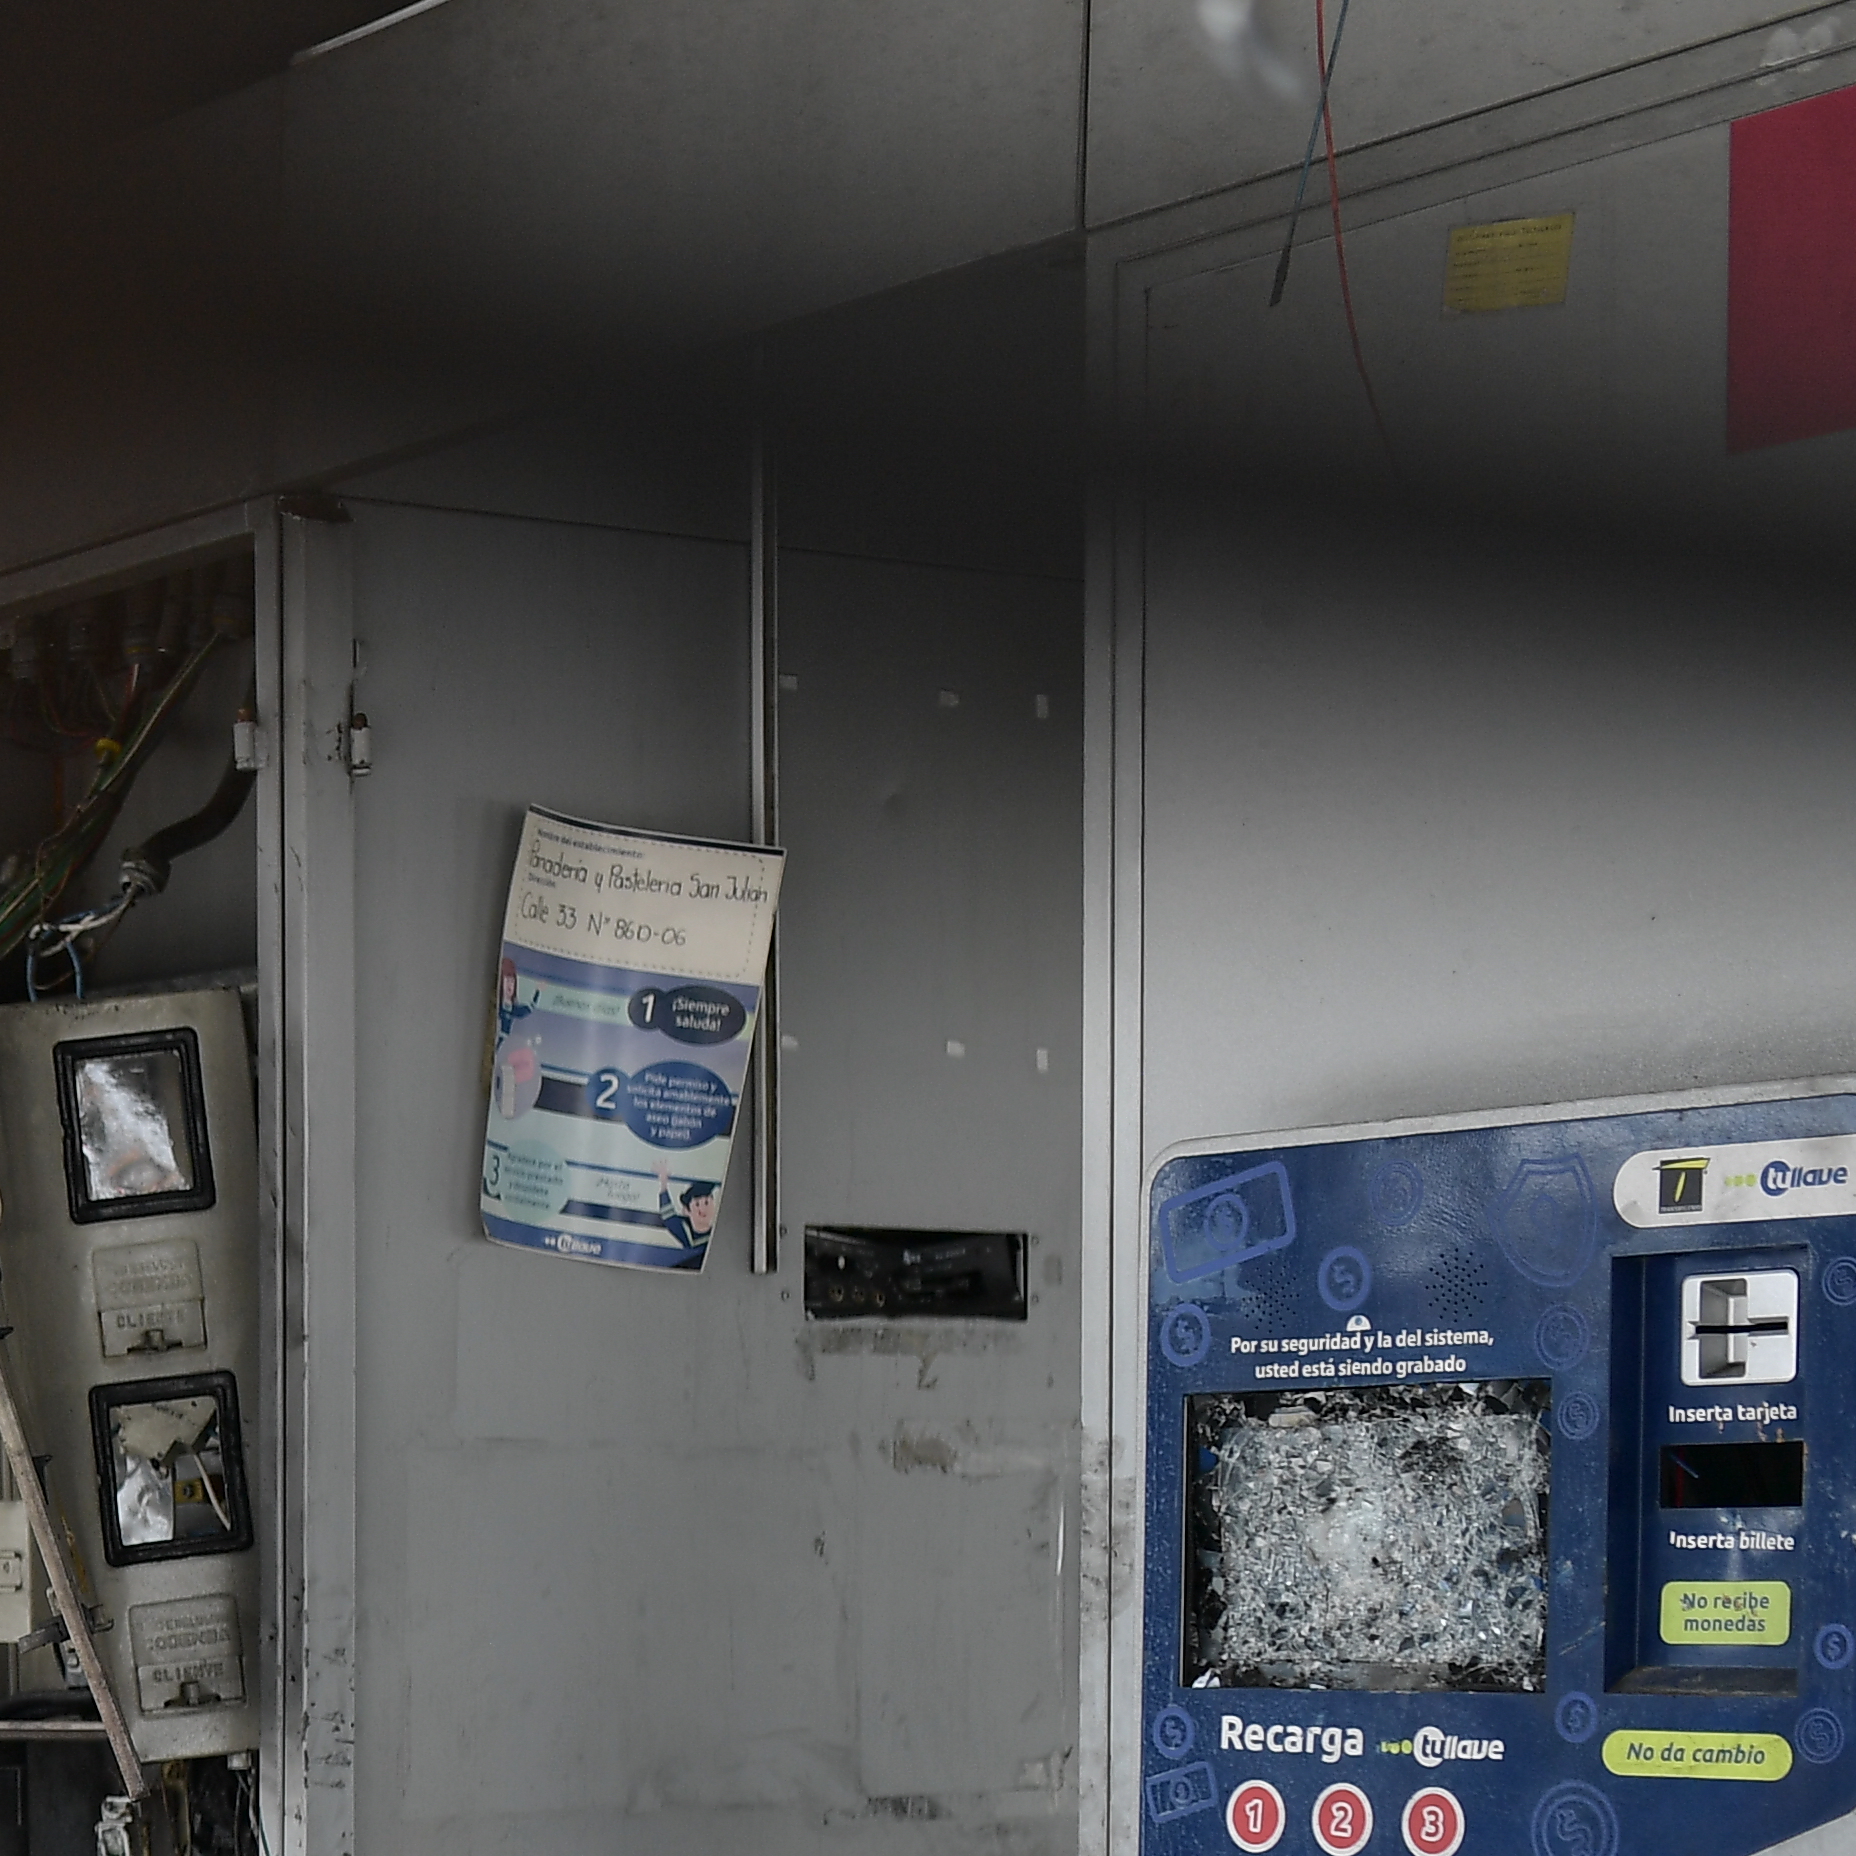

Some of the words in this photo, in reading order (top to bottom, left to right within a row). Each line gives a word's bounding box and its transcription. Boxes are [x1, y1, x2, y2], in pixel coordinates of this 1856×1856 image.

[594, 872, 604, 894] y
[688, 872, 721, 899] San
[556, 903, 577, 930] 33
[641, 993, 656, 1023] 1
[595, 1073, 619, 1110] 2
[1760, 1160, 1849, 1197] tullave
[1231, 1336, 1258, 1354] Por
[1260, 1340, 1279, 1353] su
[1281, 1331, 1361, 1356] seguridad
[1362, 1334, 1375, 1353] y
[1376, 1331, 1393, 1349] la
[1395, 1329, 1423, 1348] del
[1424, 1328, 1495, 1347] sistema,
[1255, 1360, 1300, 1379] usted
[1302, 1357, 1336, 1378] está
[1338, 1357, 1394, 1377] siendo
[1396, 1354, 1466, 1379] grabado
[1668, 1404, 1733, 1423] Inserta
[1737, 1401, 1798, 1425] tarjeta
[1669, 1530, 1734, 1549] Inserta
[1739, 1531, 1795, 1551] billete
[1681, 1593, 1708, 1610] No
[1712, 1592, 1770, 1610] recibe
[1683, 1615, 1767, 1633] monedas
[1219, 1714, 1364, 1764] Recarga
[1412, 1725, 1505, 1768] tullave
[1626, 1742, 1655, 1762] No
[1660, 1742, 1685, 1763] da
[1692, 1744, 1766, 1765] cambio
[1244, 1798, 1264, 1834] 1
[1329, 1801, 1354, 1839] 2
[1420, 1805, 1445, 1842] 3
